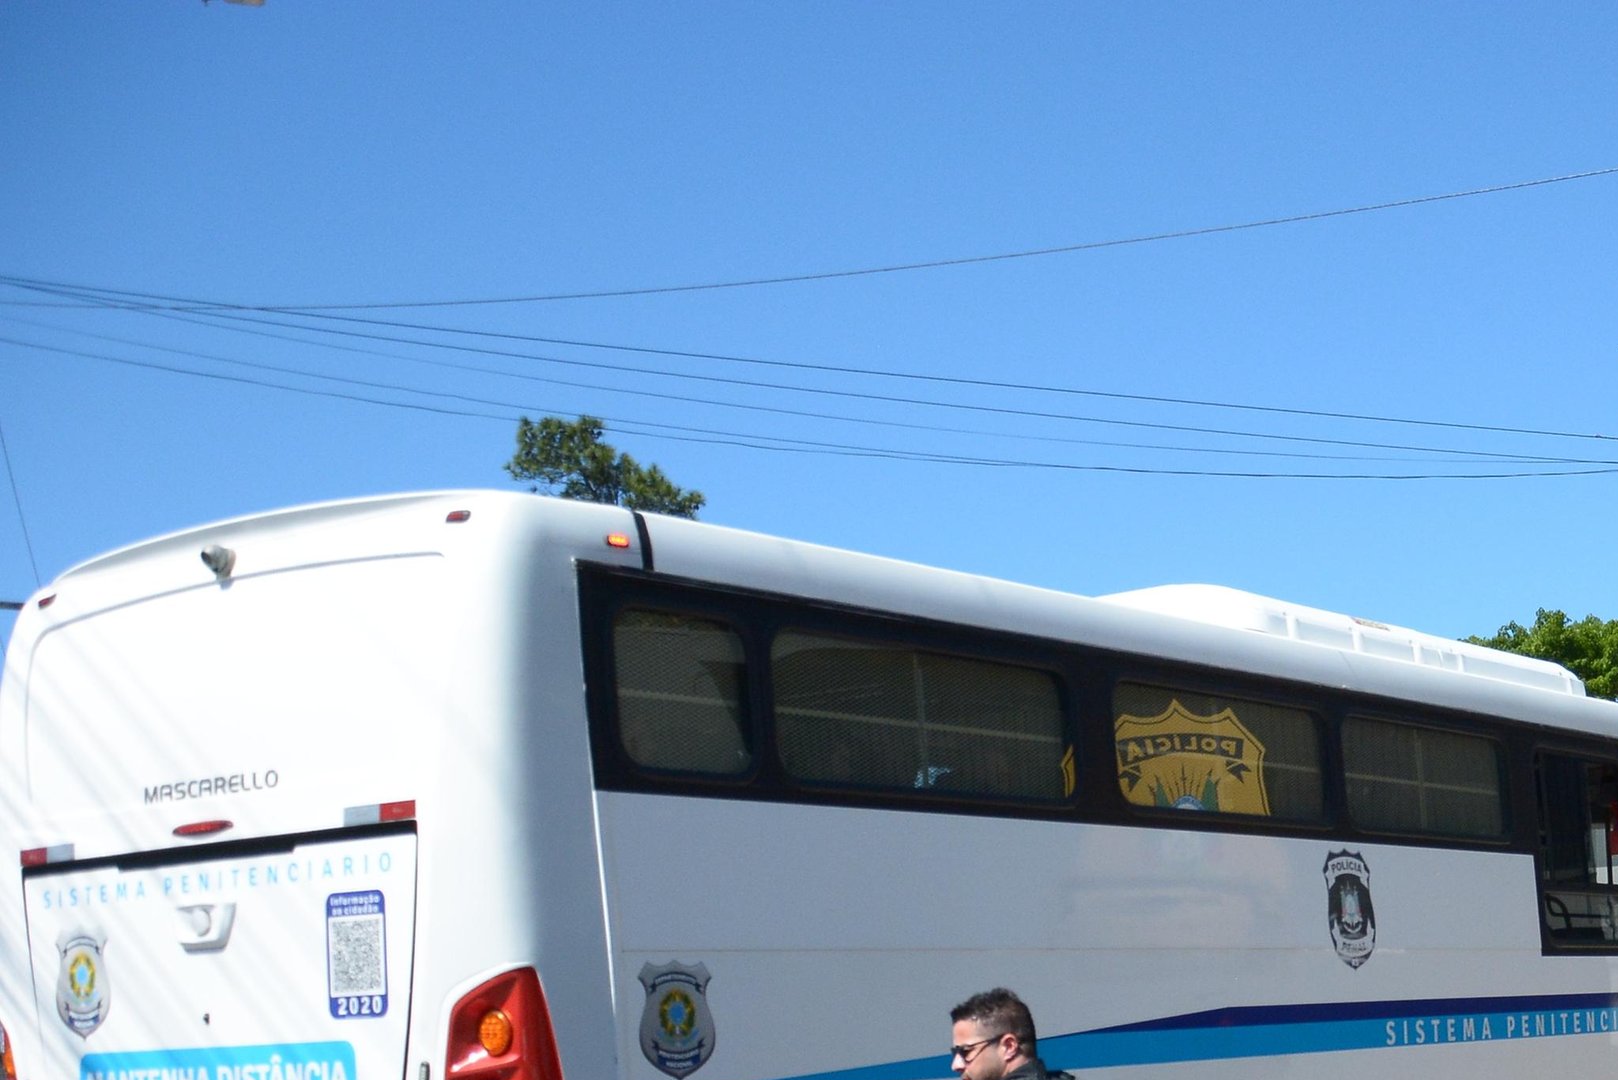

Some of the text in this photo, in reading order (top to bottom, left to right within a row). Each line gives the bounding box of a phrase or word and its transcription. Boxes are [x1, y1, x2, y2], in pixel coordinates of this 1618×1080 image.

[144, 769, 279, 805] MASCARELLO
[43, 880, 145, 909] SISTEMA
[337, 995, 383, 1016] 2020
[1386, 1017, 1492, 1046] SISTEMA
